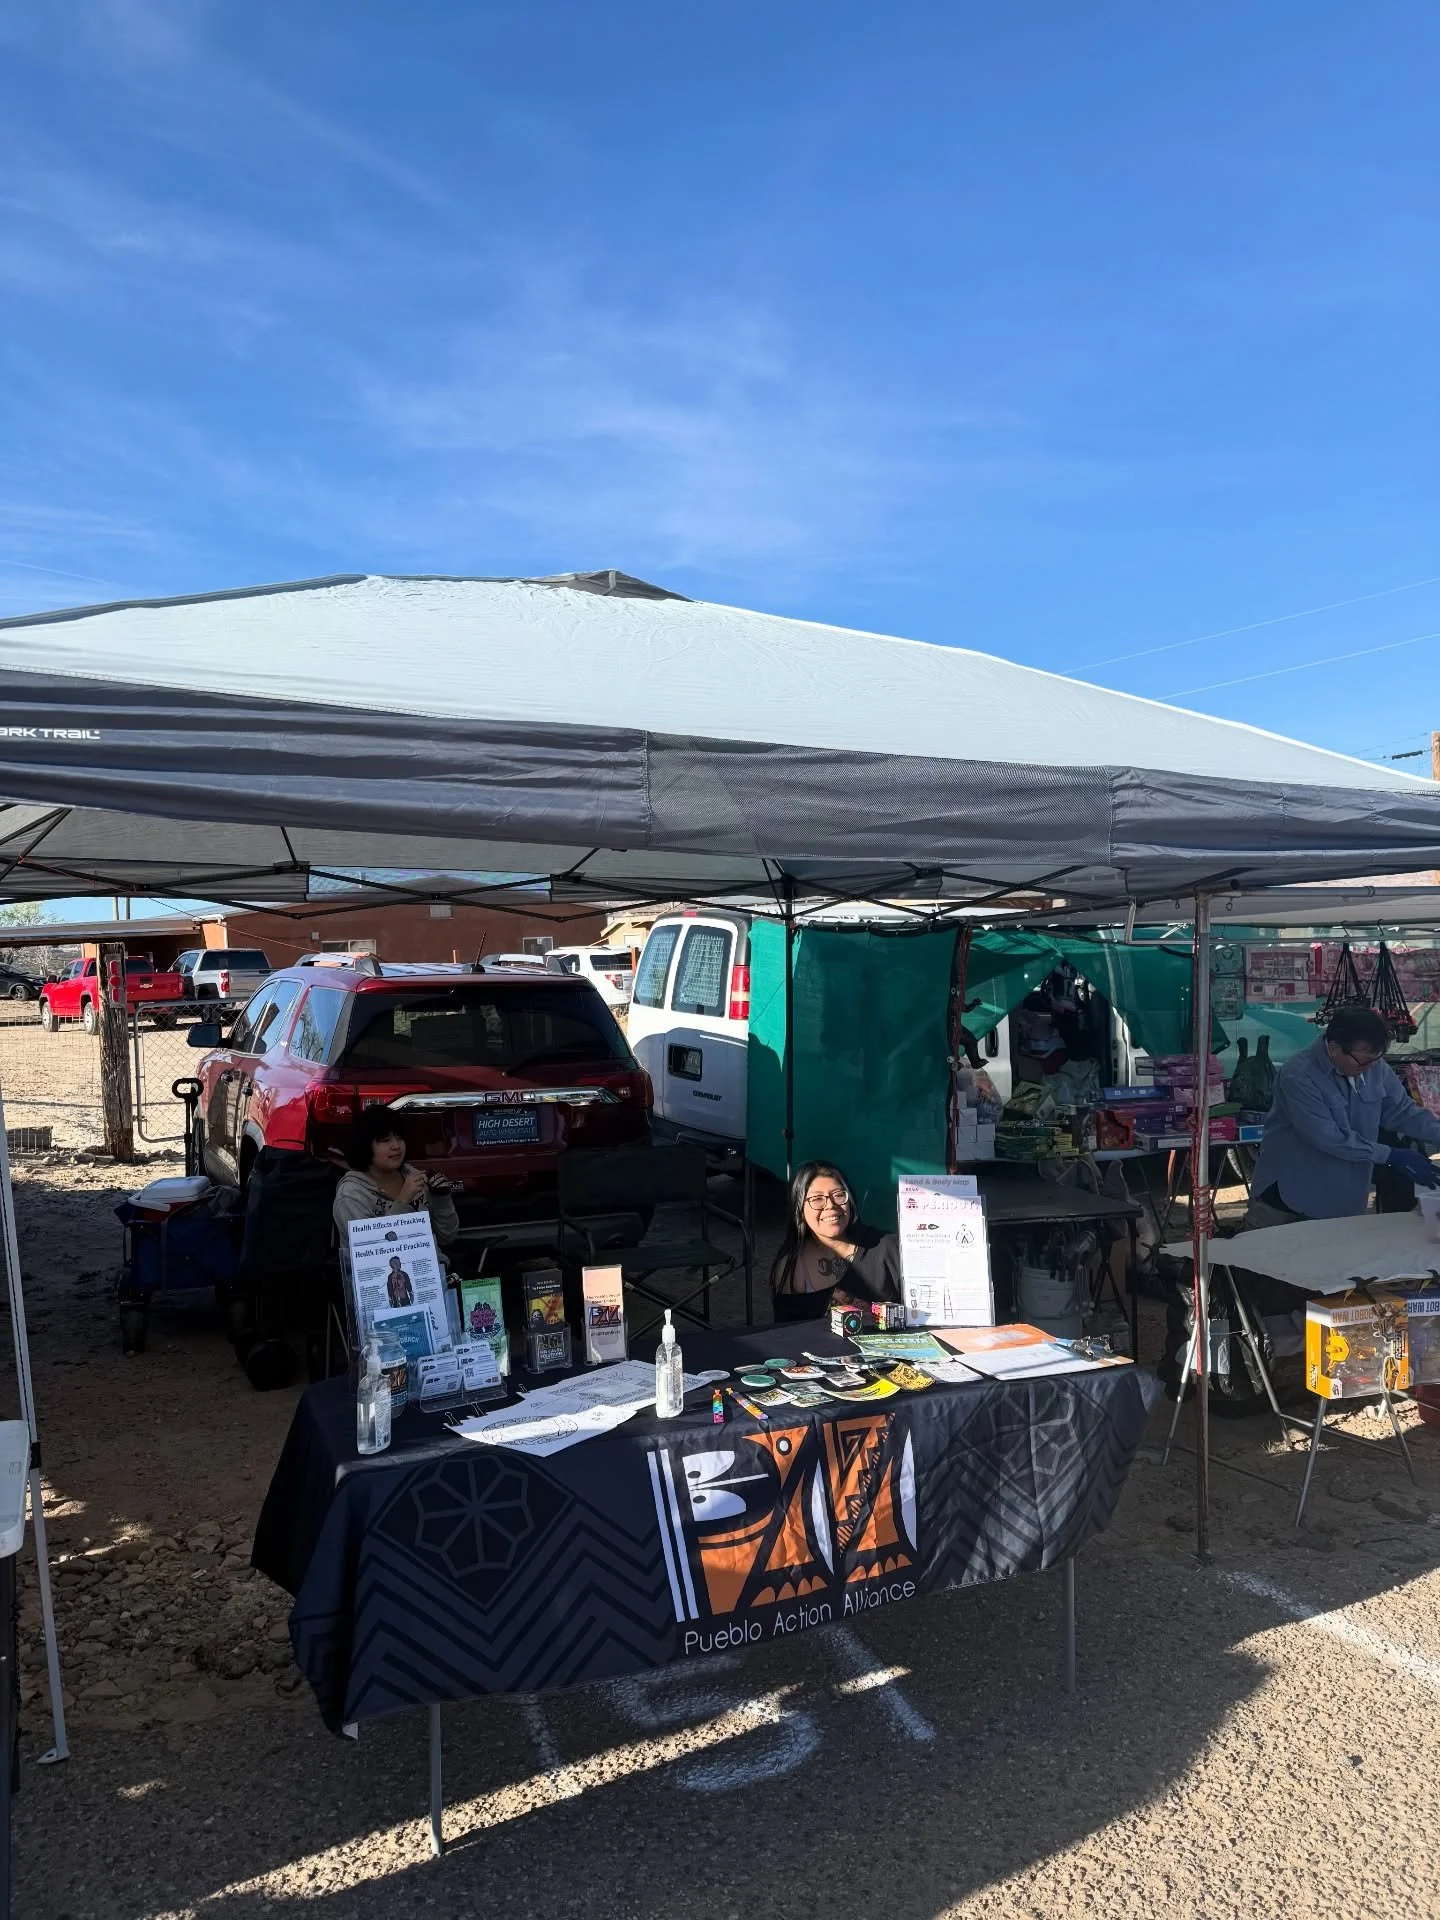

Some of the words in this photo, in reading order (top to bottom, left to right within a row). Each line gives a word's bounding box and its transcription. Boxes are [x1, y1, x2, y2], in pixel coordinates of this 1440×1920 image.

[484, 1091, 536, 1104] GMC
[479, 1119, 500, 1129] HIGH
[502, 1117, 535, 1128] DESERT
[499, 1127, 536, 1136] WHOLESALE
[352, 1224, 372, 1233] Health
[373, 1220, 393, 1230] Effects
[393, 1219, 400, 1227] of
[400, 1217, 426, 1226] Fracking
[355, 1249, 374, 1259] Health
[375, 1247, 395, 1256] Effects
[403, 1241, 431, 1251] Fracking
[684, 1619, 762, 1655] Pueblo
[772, 1602, 832, 1636] Action
[843, 1580, 916, 1617] Alliance
